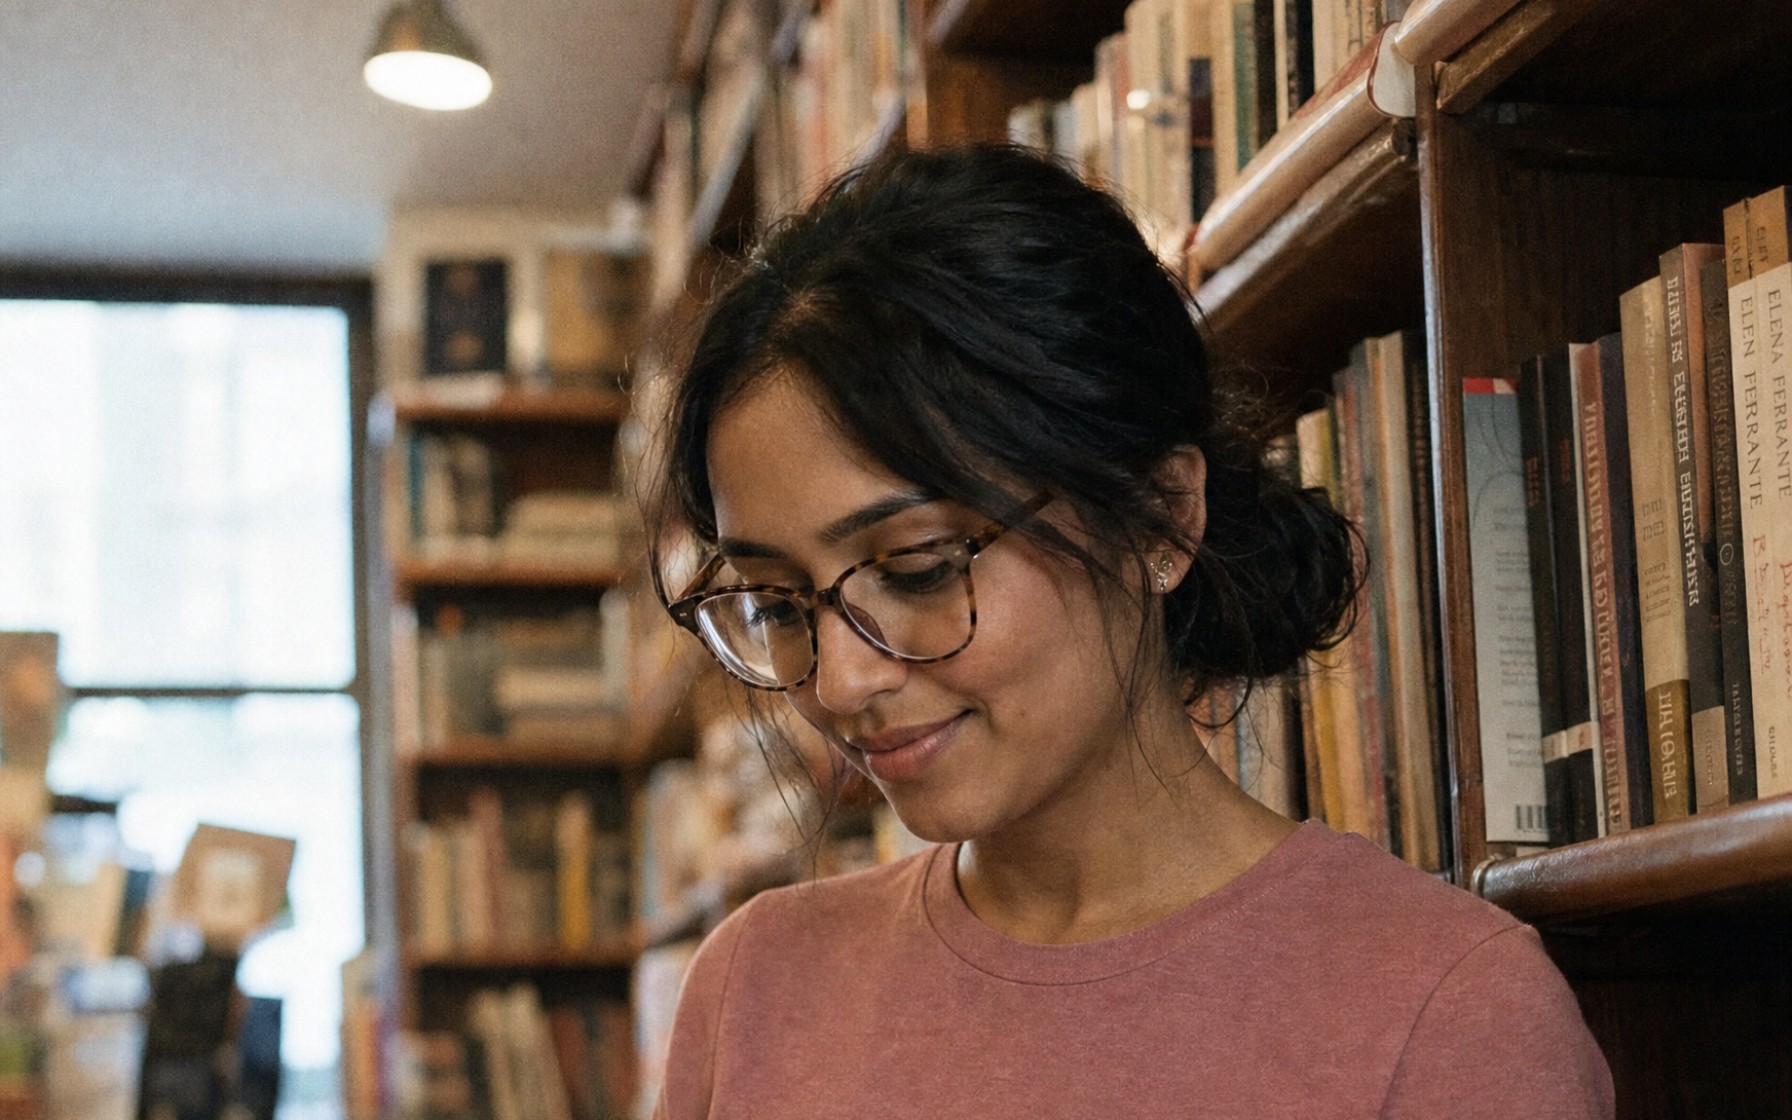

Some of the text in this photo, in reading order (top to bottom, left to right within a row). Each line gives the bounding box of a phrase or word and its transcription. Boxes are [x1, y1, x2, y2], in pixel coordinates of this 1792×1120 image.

[1740, 296, 1763, 510] ELEN FERRANTE
[1768, 289, 1792, 499] ELENA FERRANTE
